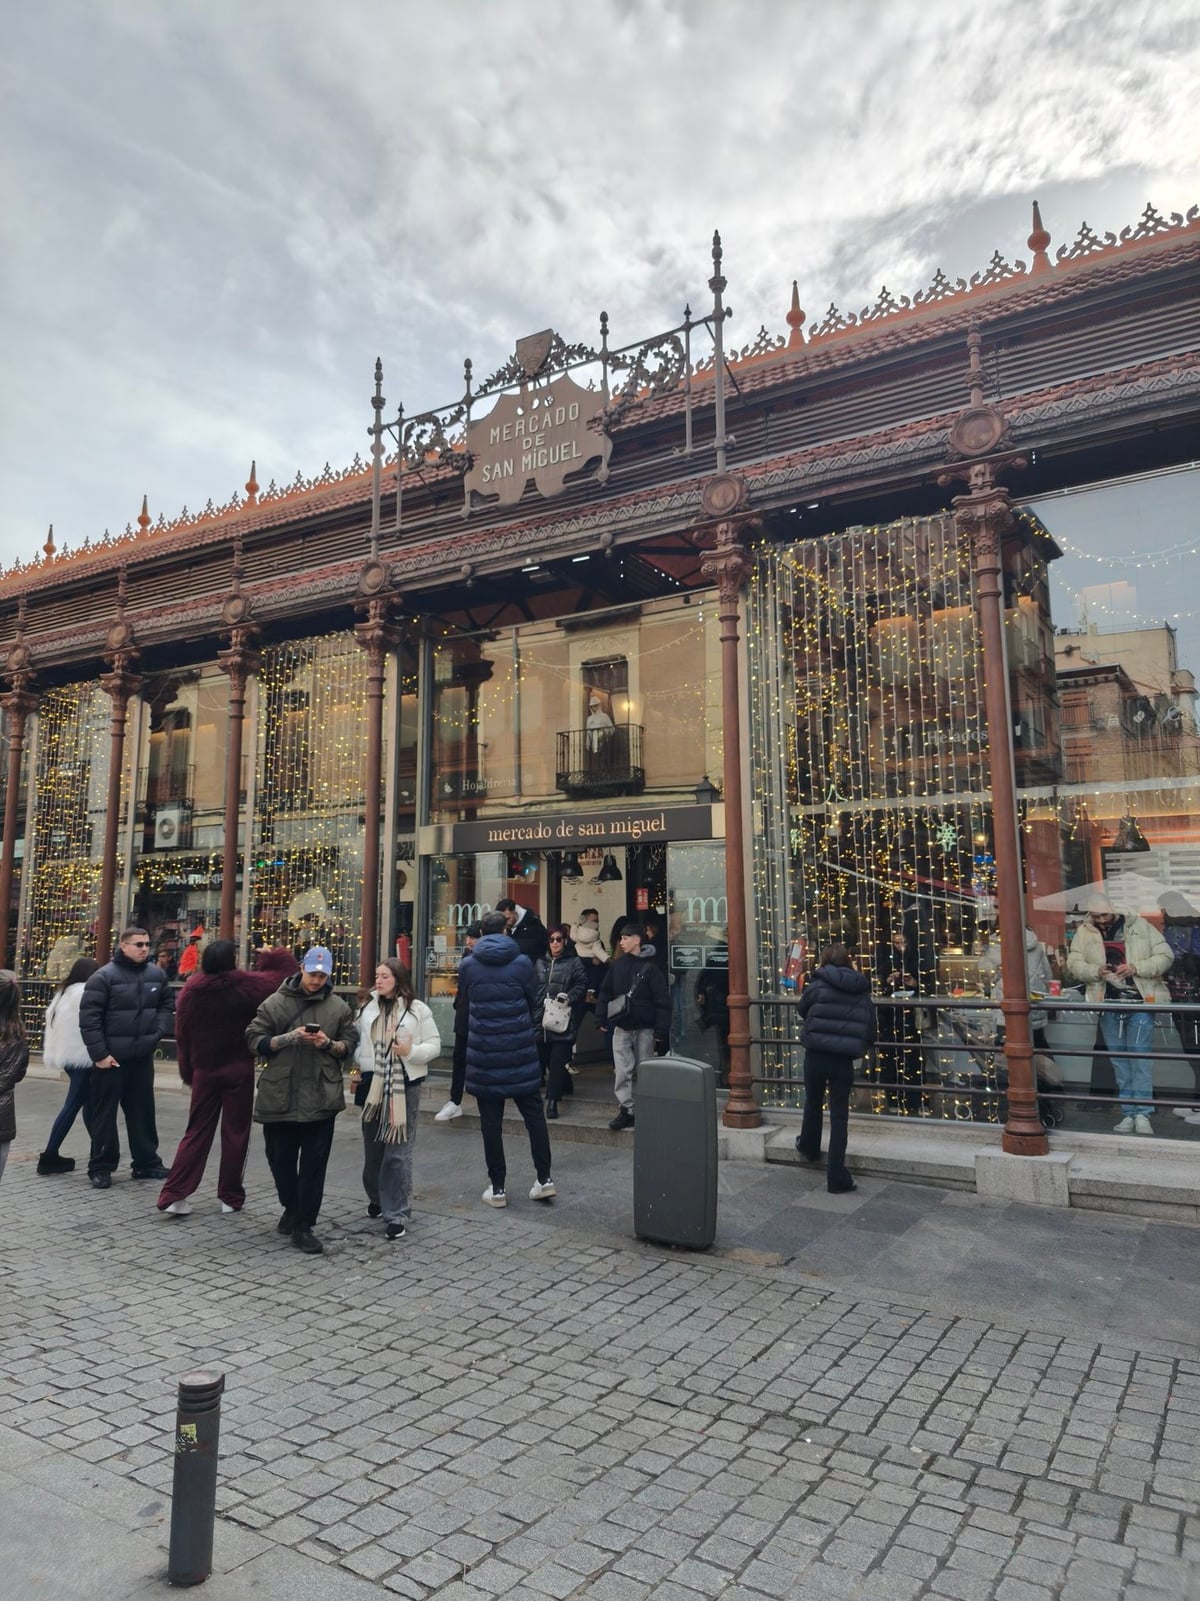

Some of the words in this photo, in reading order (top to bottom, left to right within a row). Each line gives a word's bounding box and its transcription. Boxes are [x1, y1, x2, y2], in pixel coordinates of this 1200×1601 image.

[490, 402, 579, 445] MERCADO
[522, 433, 545, 450] DE
[482, 458, 514, 483] SAN
[487, 821, 552, 842] mercado
[555, 820, 575, 838] de
[578, 822, 606, 837] san
[610, 813, 667, 840] miguel
